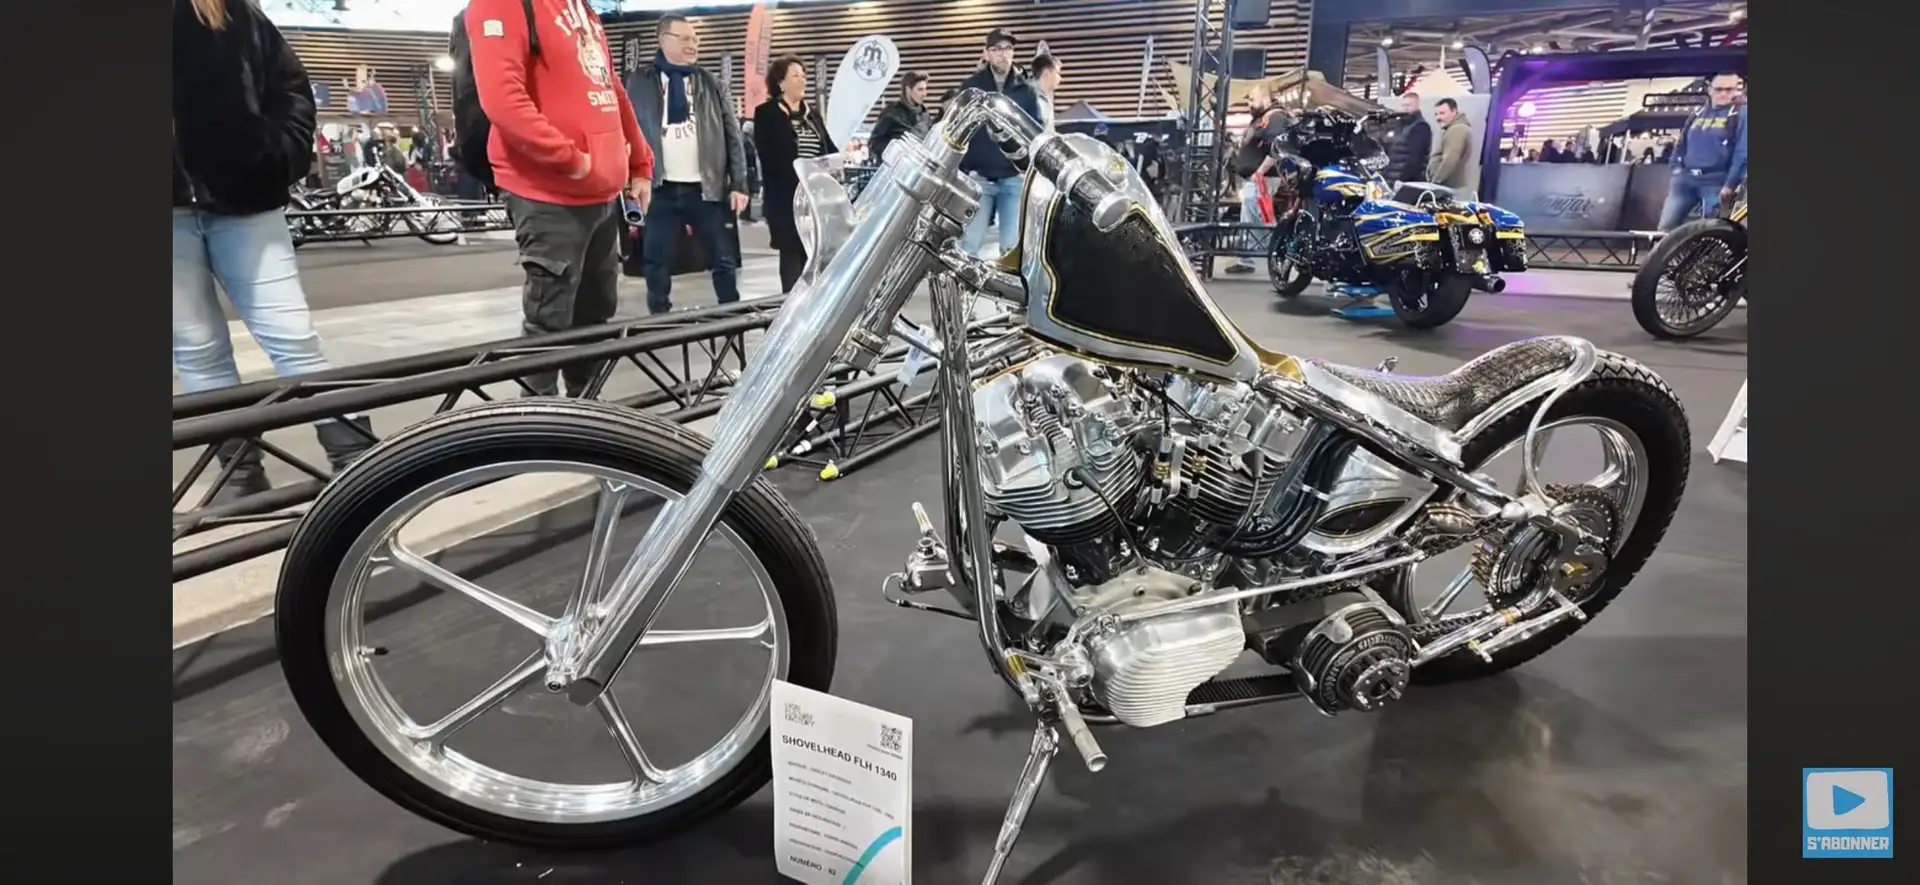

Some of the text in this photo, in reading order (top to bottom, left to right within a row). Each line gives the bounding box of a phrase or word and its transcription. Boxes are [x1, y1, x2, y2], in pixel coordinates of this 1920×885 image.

[782, 734, 852, 763] SHOVELHEAD
[853, 755, 873, 771] FLH
[874, 766, 898, 782] 1340
